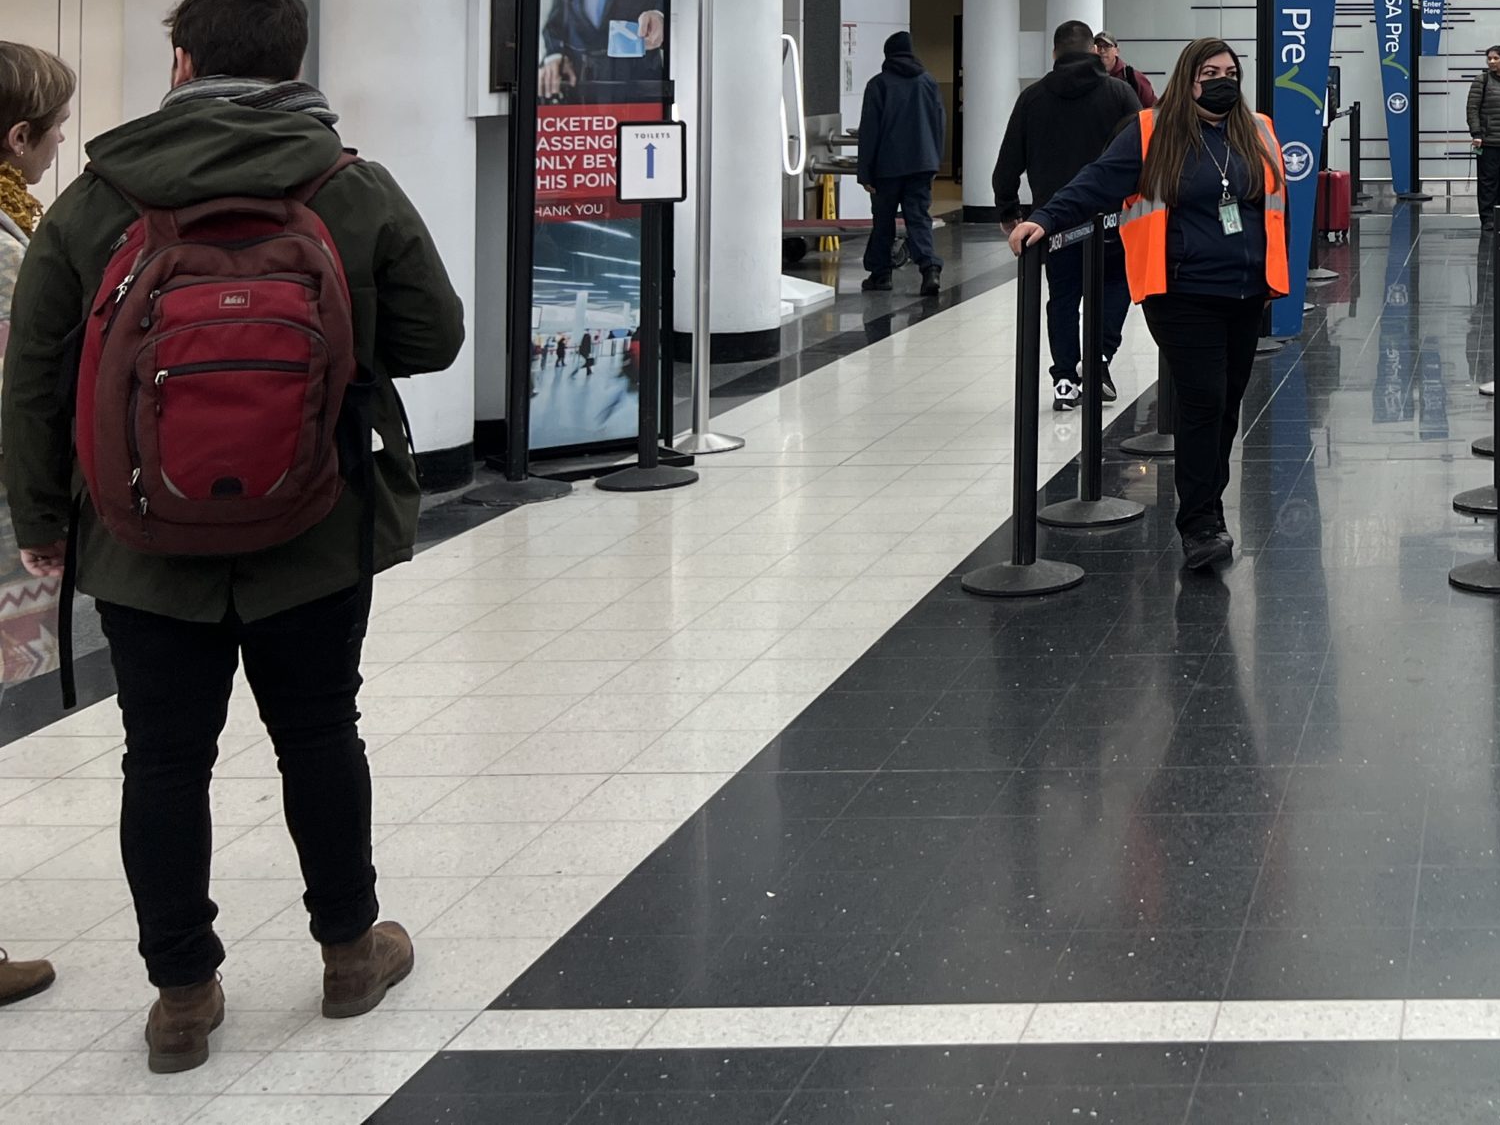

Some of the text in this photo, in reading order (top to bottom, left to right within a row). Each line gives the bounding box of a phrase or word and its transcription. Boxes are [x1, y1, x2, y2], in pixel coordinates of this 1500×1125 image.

[1422, 0, 1442, 8] Enter
[1423, 7, 1441, 15] Here
[1281, 8, 1311, 64] Pre
[1384, 23, 1402, 53] Pre
[537, 115, 618, 132] ICKETED
[536, 135, 617, 151] ASSENG
[635, 132, 671, 140] TOILETS
[583, 153, 617, 169] BEY
[536, 174, 568, 190] HIS
[573, 172, 617, 188] POIN
[535, 203, 603, 218] HANK YOU
